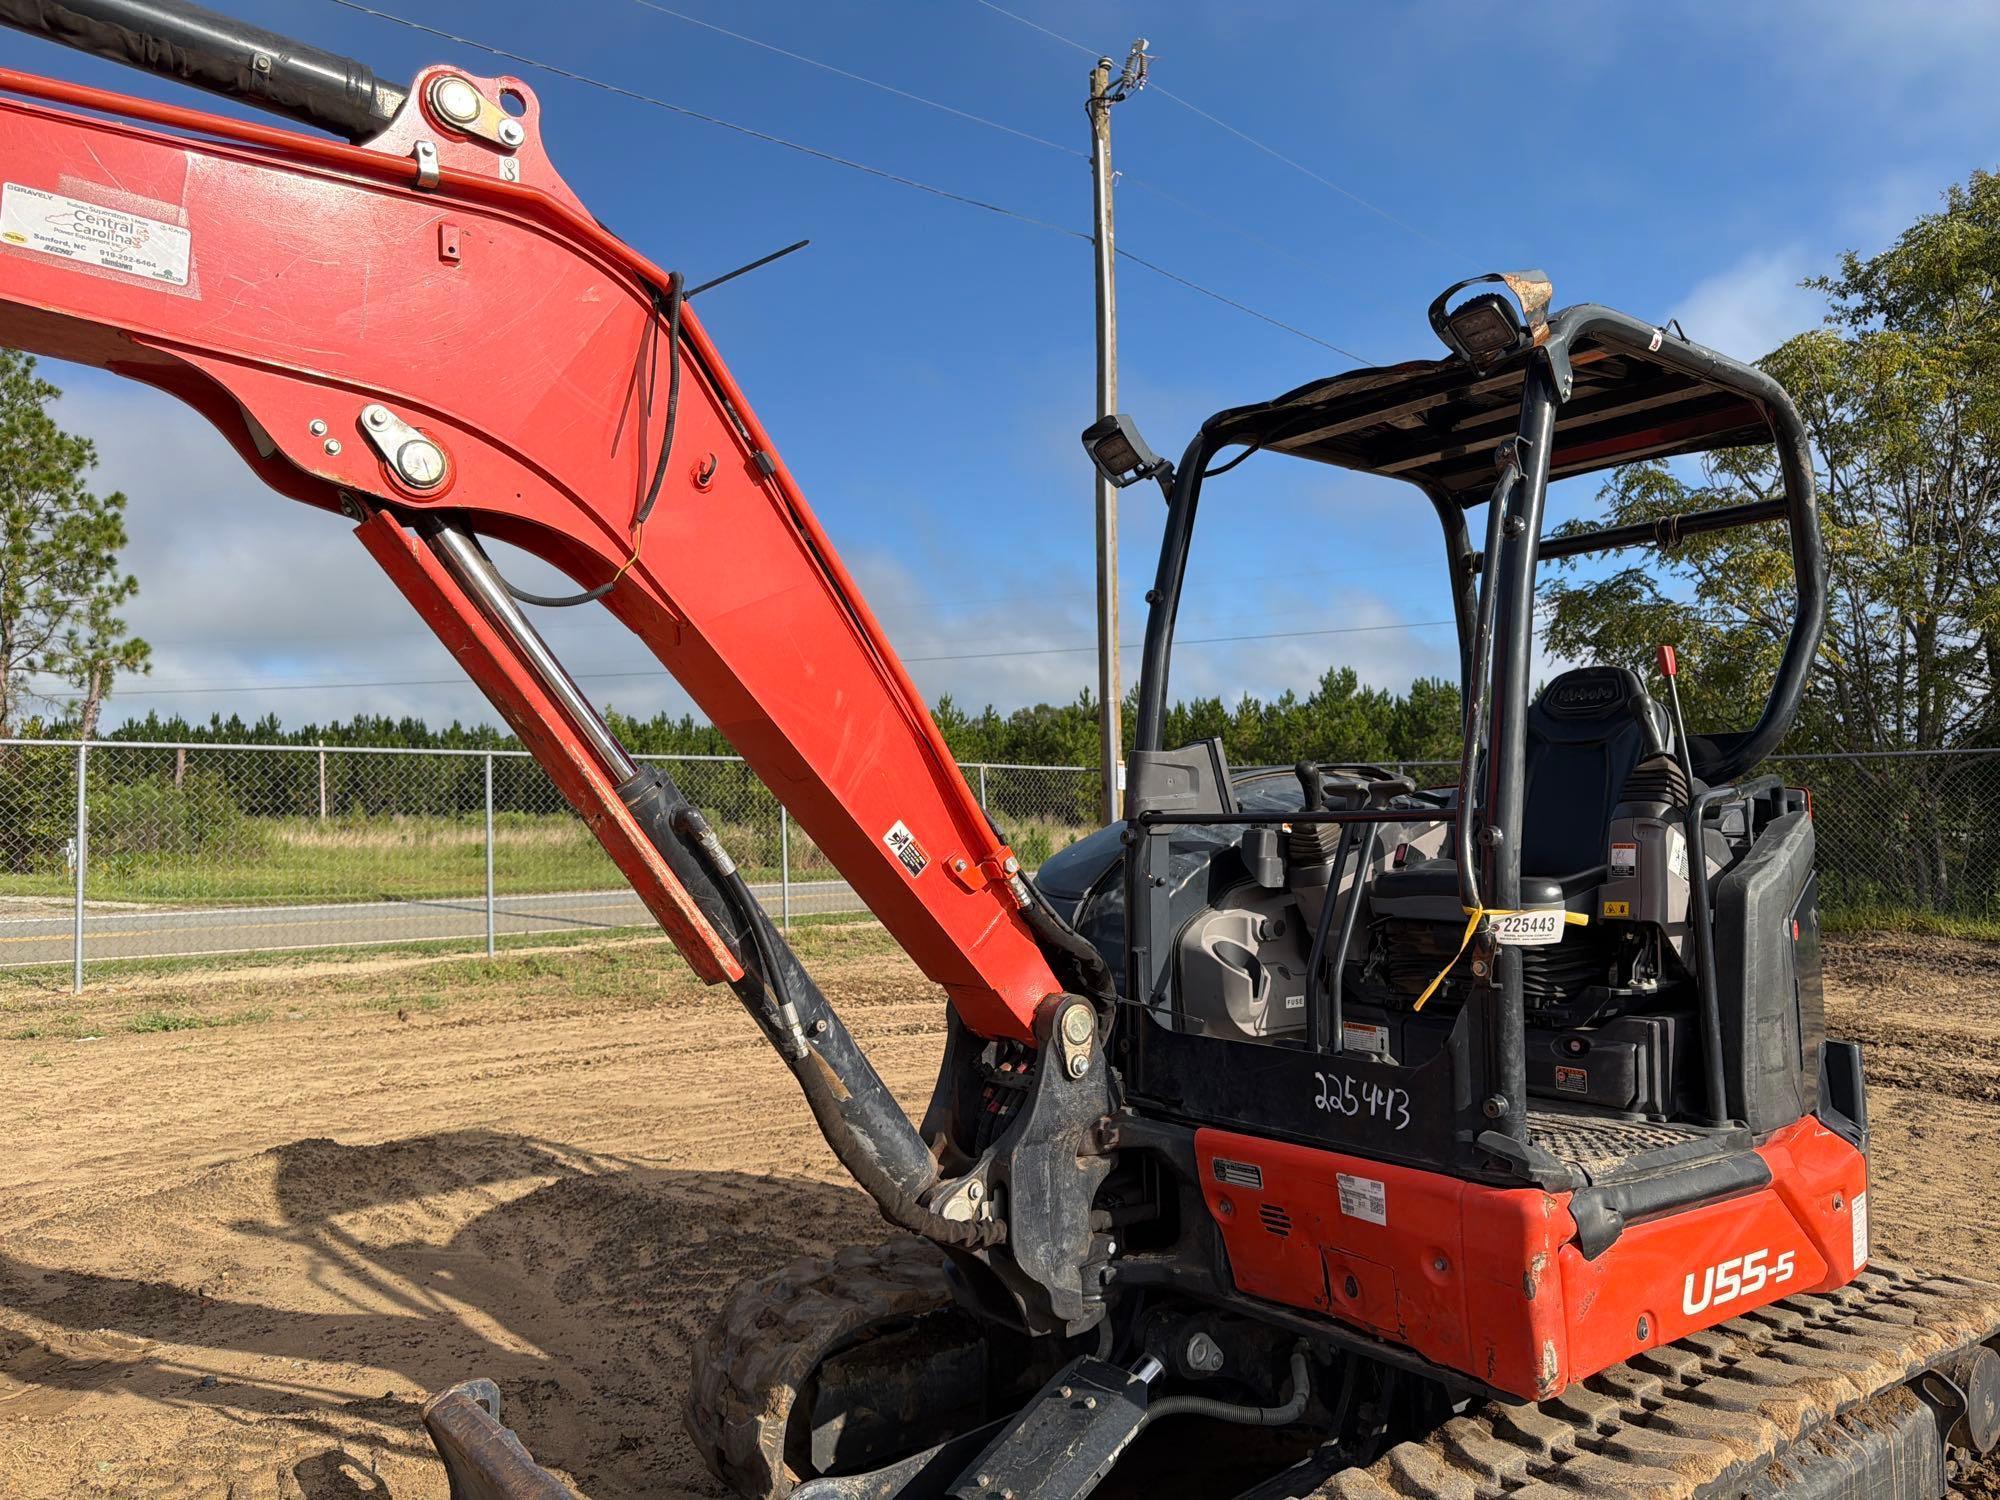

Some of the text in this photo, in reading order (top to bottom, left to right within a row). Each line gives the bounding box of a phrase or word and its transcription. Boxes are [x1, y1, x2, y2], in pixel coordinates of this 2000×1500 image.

[74, 210, 134, 234] Central
[33, 233, 71, 248] Sanford,
[74, 243, 87, 251] NC
[73, 223, 133, 245] Carolina
[1503, 917, 1555, 933] 225443
[1287, 998, 1303, 1006] FUSE
[1315, 1071, 1410, 1130] 225443
[1682, 1248, 1796, 1316] U55-5
